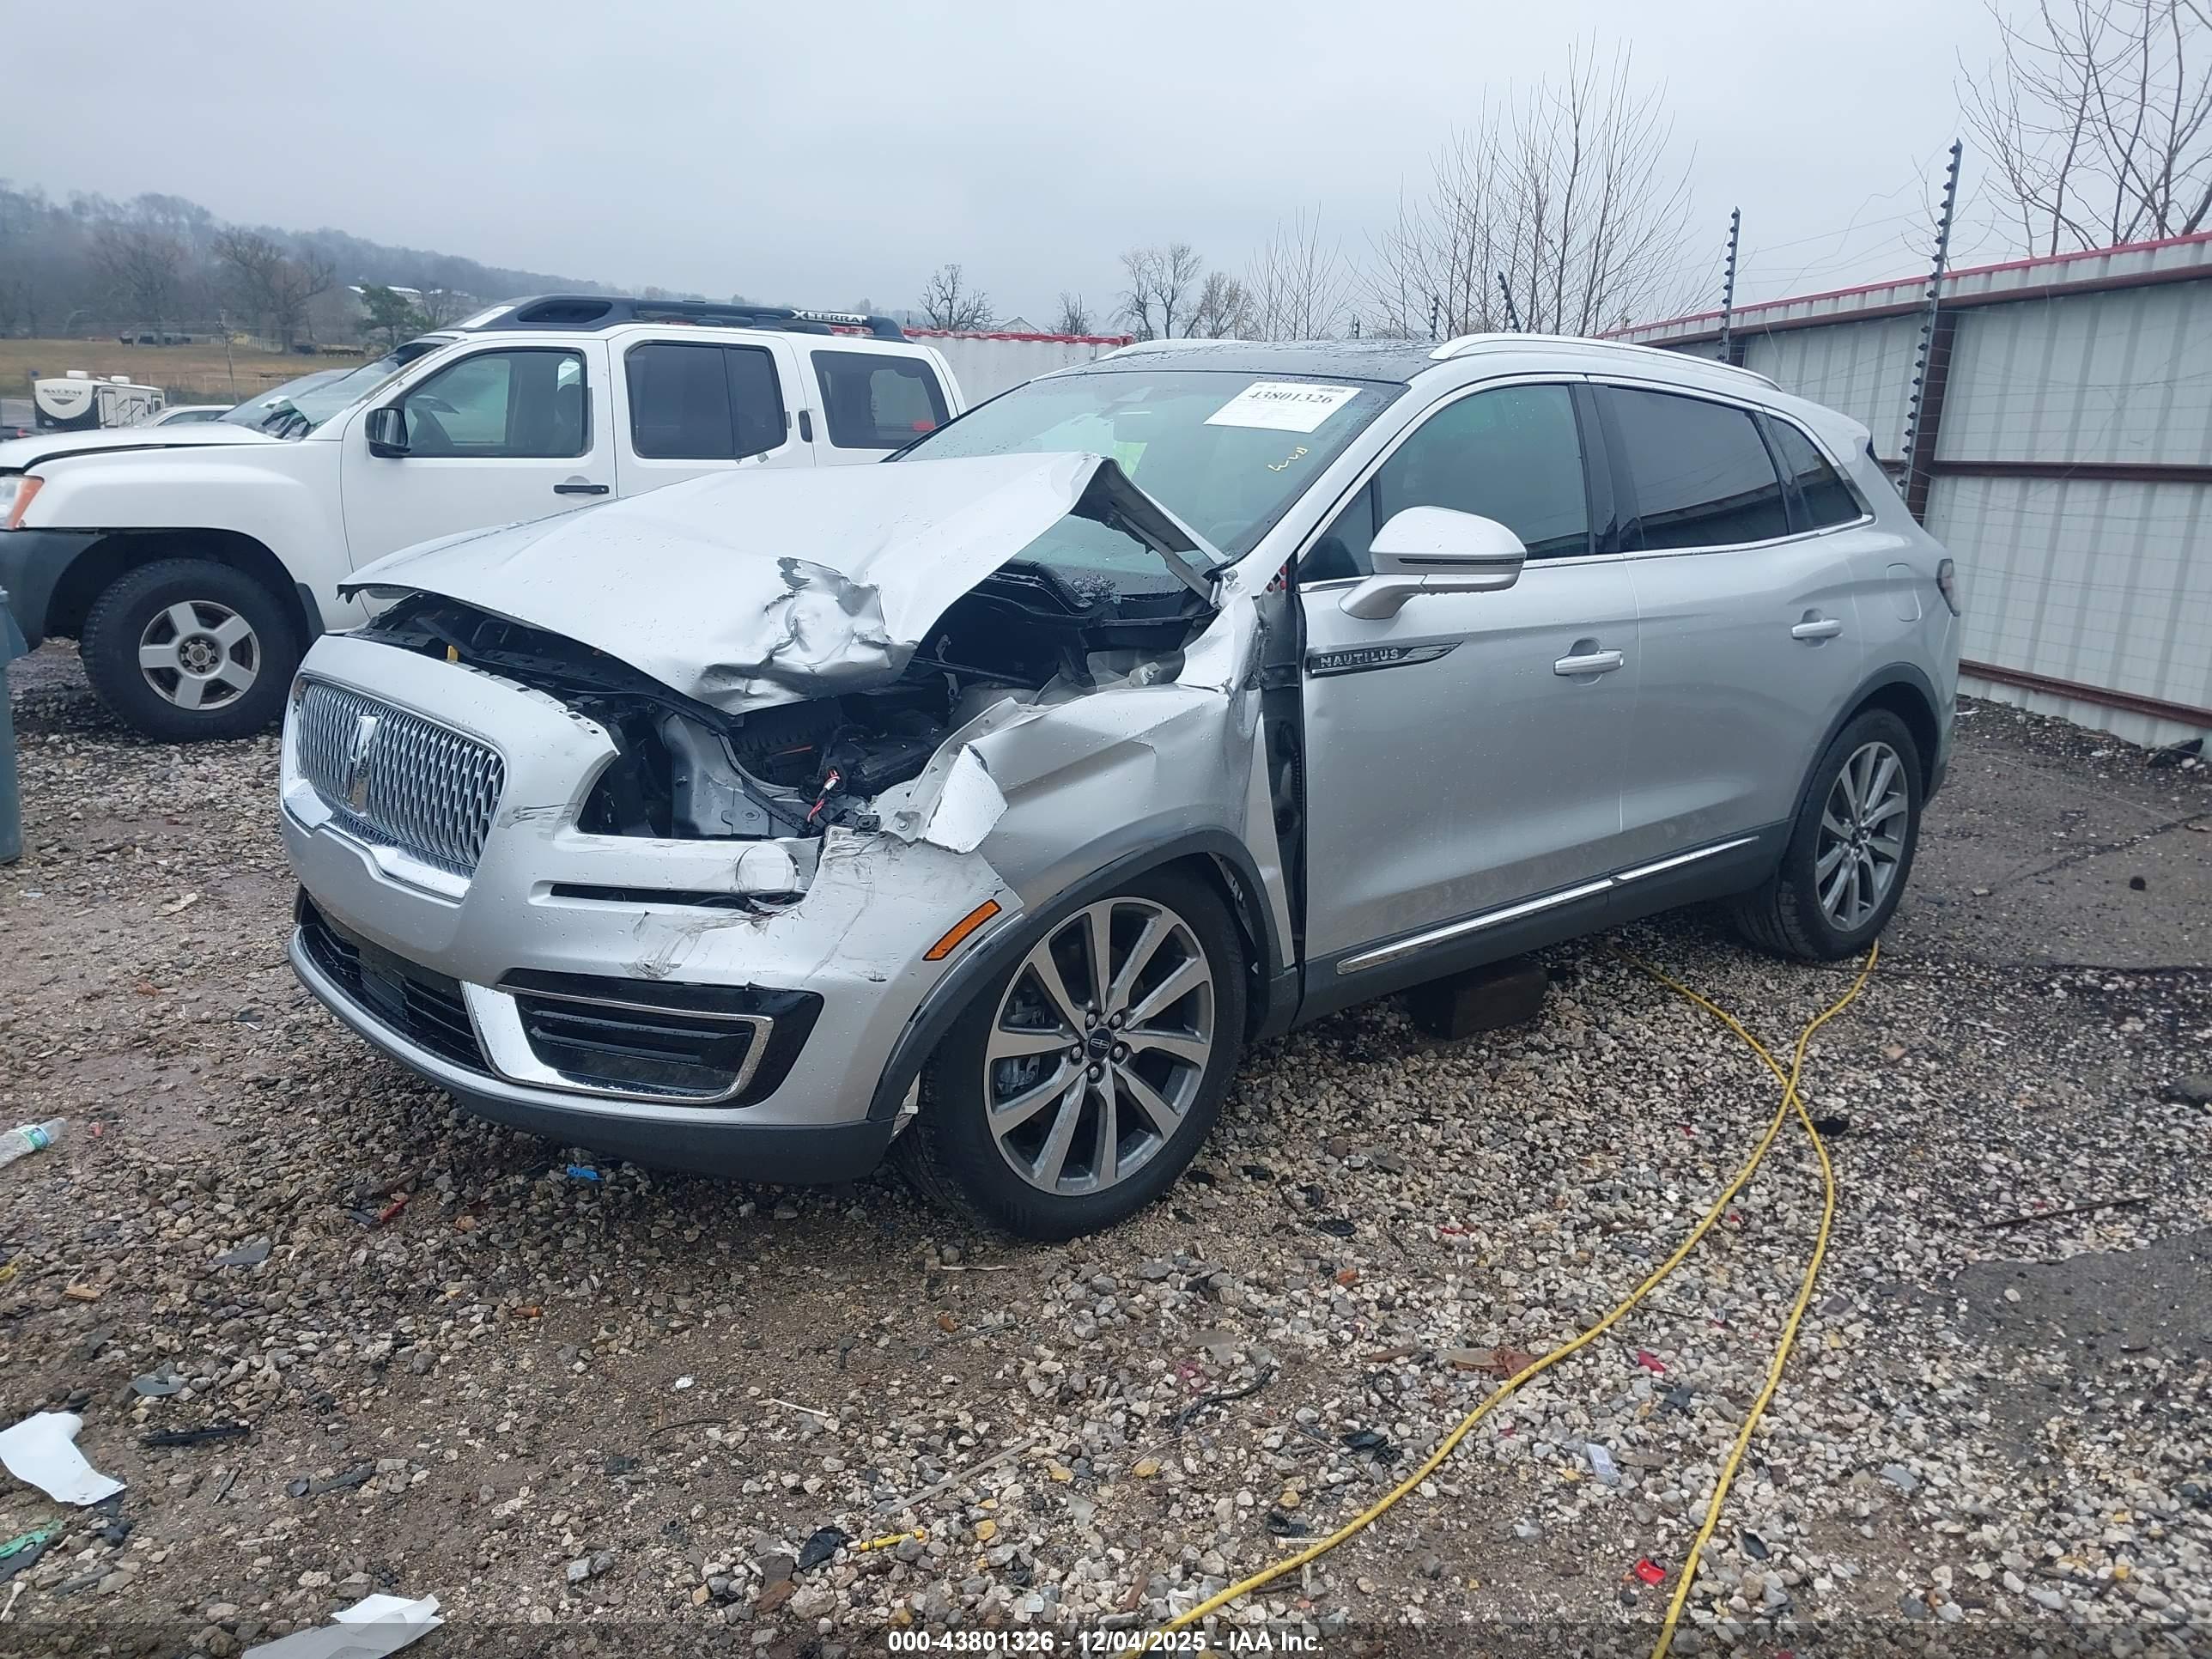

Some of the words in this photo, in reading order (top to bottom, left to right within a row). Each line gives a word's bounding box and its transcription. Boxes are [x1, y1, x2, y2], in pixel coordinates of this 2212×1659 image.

[790, 309, 862, 324] XTERRA
[1248, 391, 1334, 404] 43801326
[1320, 649, 1399, 667] NAUTILUS
